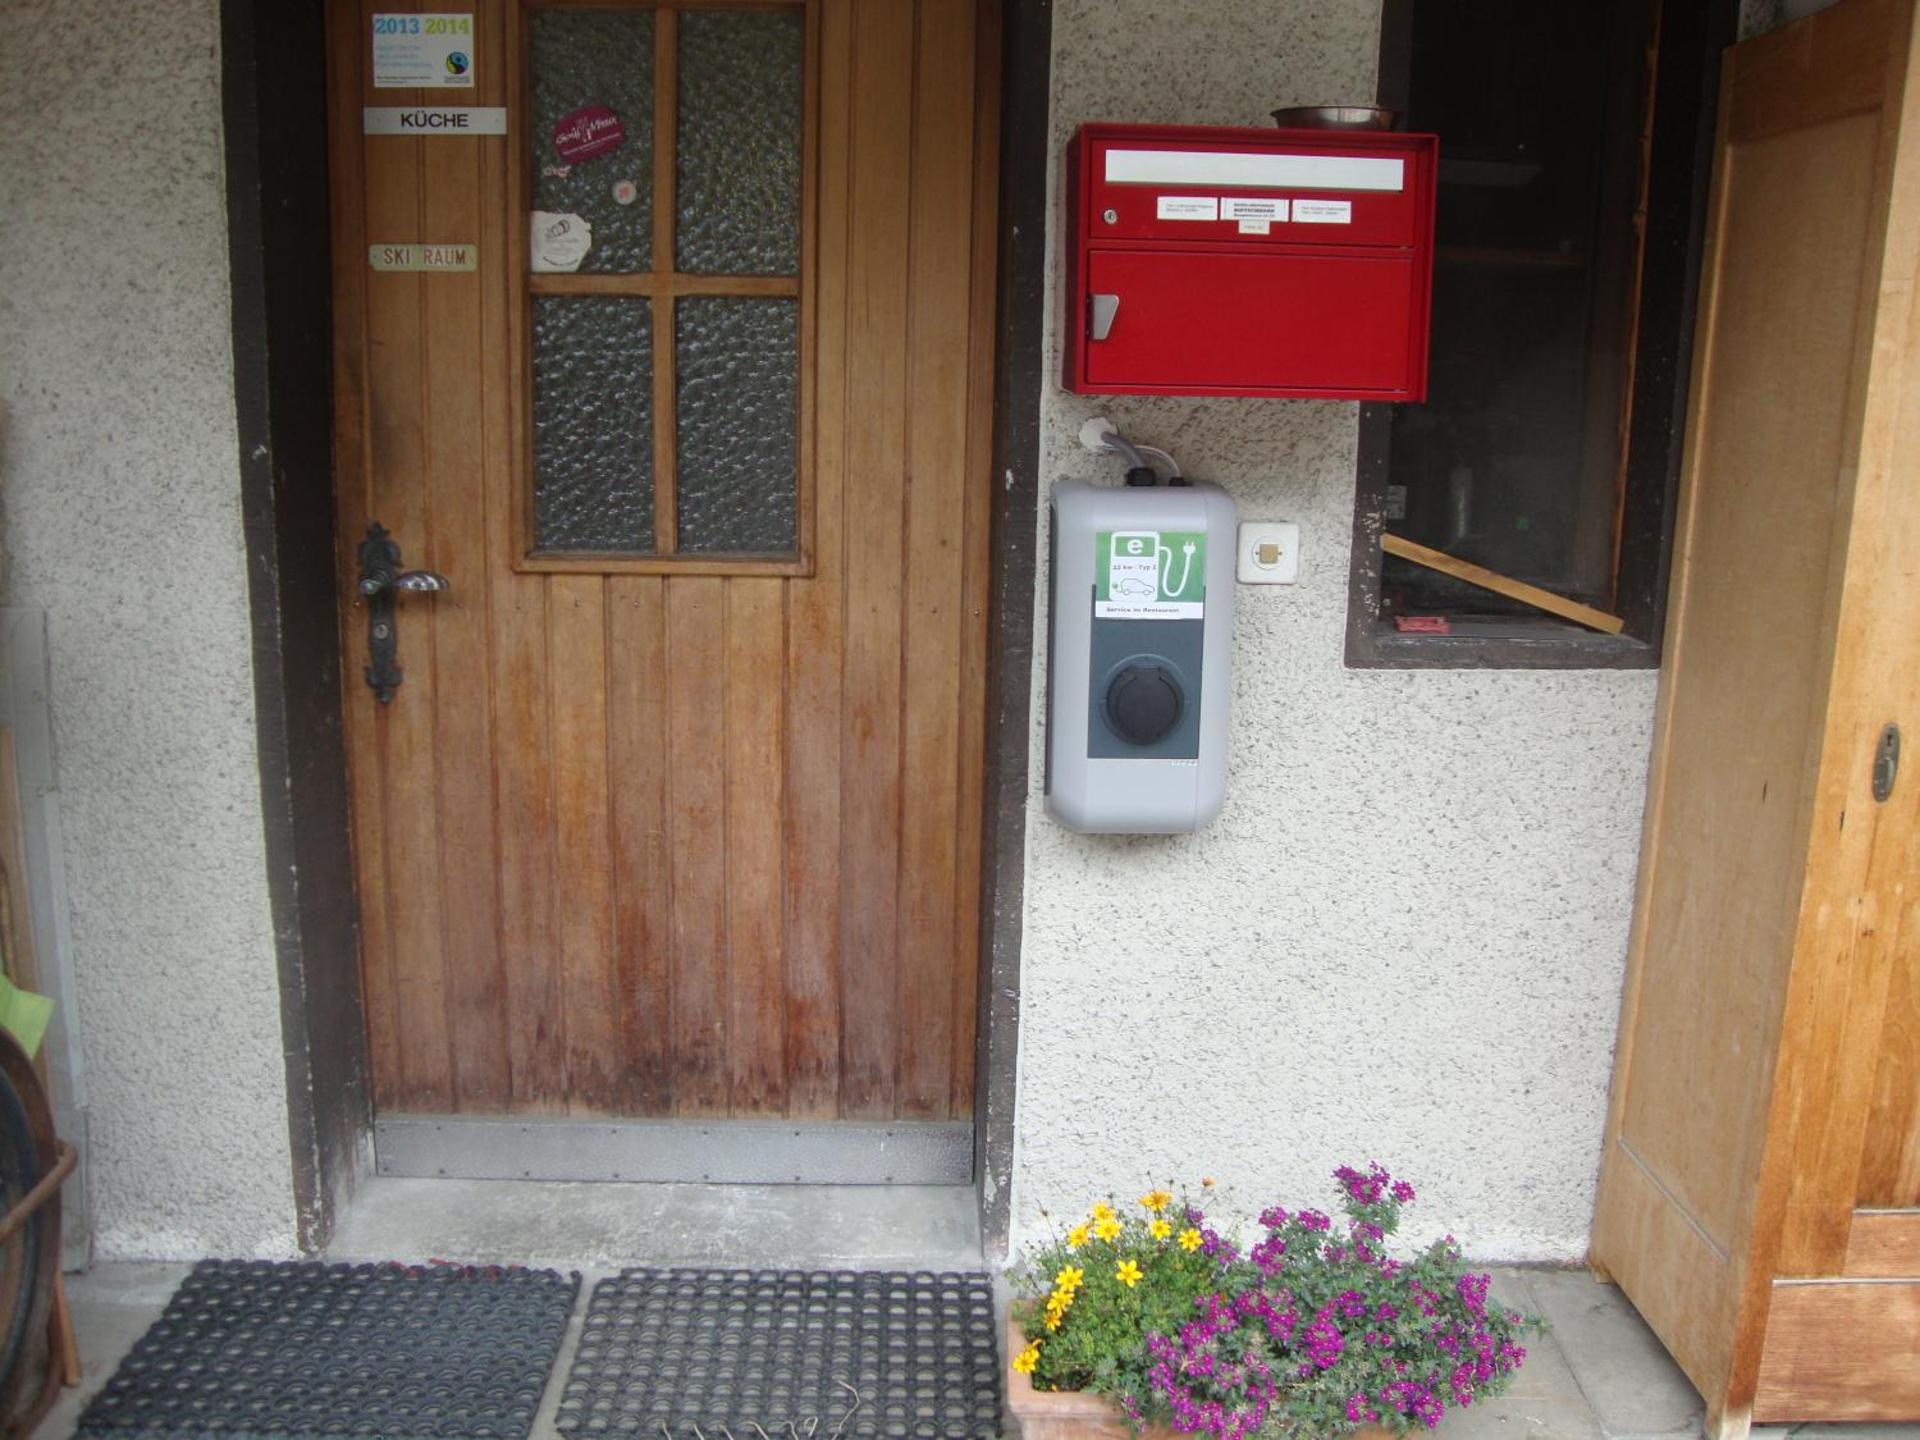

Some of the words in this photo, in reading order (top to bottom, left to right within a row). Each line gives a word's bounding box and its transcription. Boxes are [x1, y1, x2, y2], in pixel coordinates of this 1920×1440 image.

[376, 17, 420, 34] 2013
[425, 17, 469, 34] 2014
[401, 111, 469, 128] KÜCHE
[384, 248, 410, 265] SKI
[423, 248, 466, 265] RAUM
[1127, 539, 1143, 554] e
[1139, 564, 1151, 572] Typ
